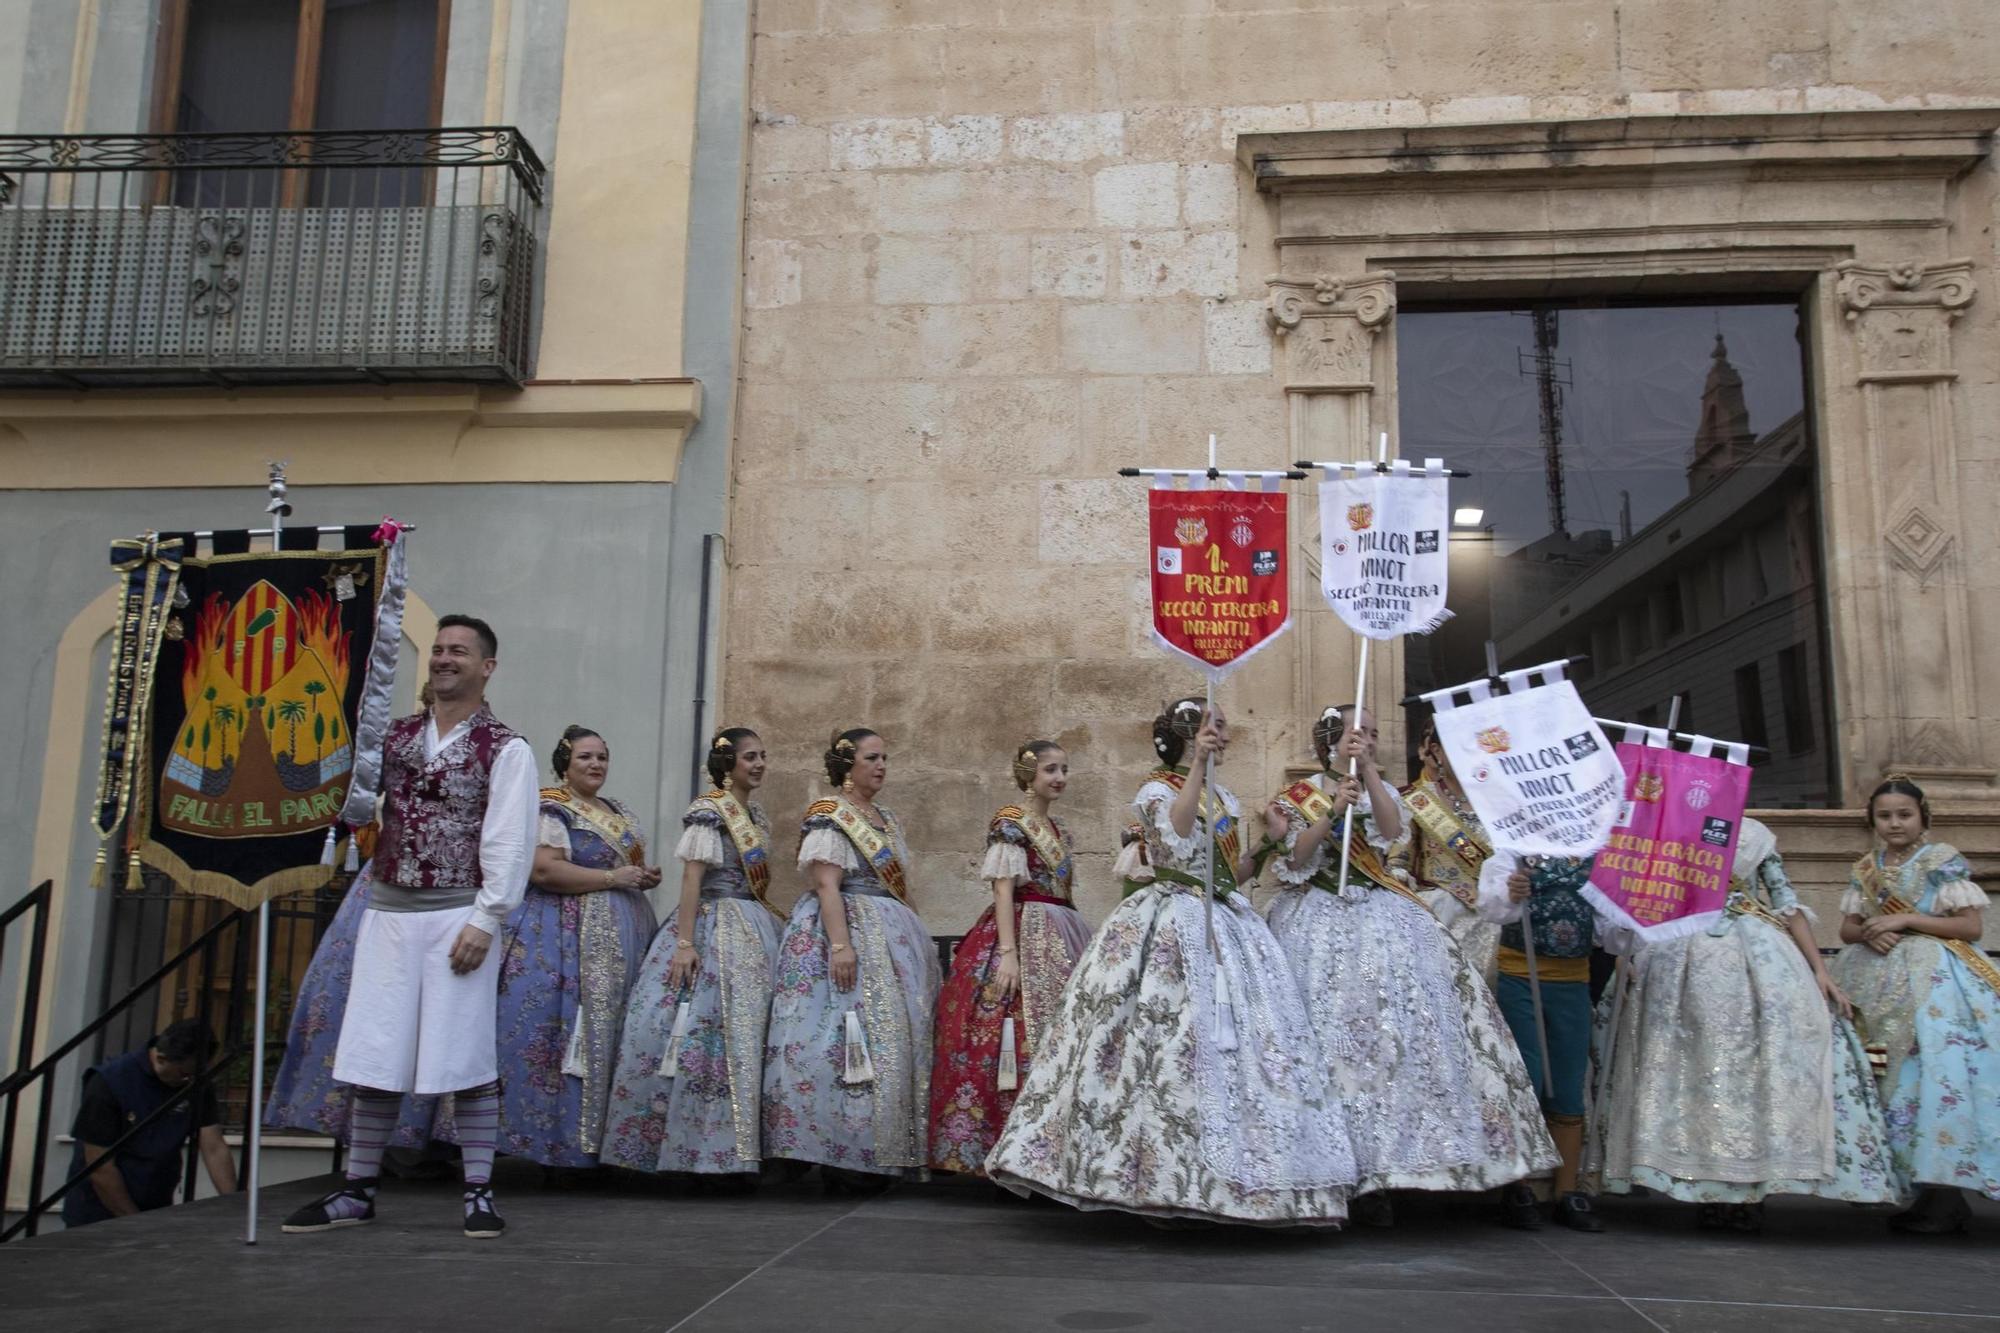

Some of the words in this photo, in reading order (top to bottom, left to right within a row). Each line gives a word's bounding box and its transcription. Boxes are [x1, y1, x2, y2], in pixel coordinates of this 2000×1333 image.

[1358, 531, 1410, 555] MILLOR
[1361, 558, 1406, 581] NINOT
[1185, 575, 1248, 596] PREMI
[1376, 583, 1439, 598] TERCERA
[1211, 600, 1279, 618] TERCERA
[1353, 597, 1413, 612] INFANTIL
[1183, 620, 1252, 636] INFANTIL
[1498, 746, 1570, 775] MILLOR
[1517, 772, 1575, 799] NINOT
[167, 794, 235, 829] FALLA
[243, 802, 272, 827] EL
[280, 787, 344, 825] PARC
[1661, 843, 1724, 871] GRÀCIA
[1600, 852, 1650, 874] SECCIÓ
[1651, 860, 1720, 891] TERCERA
